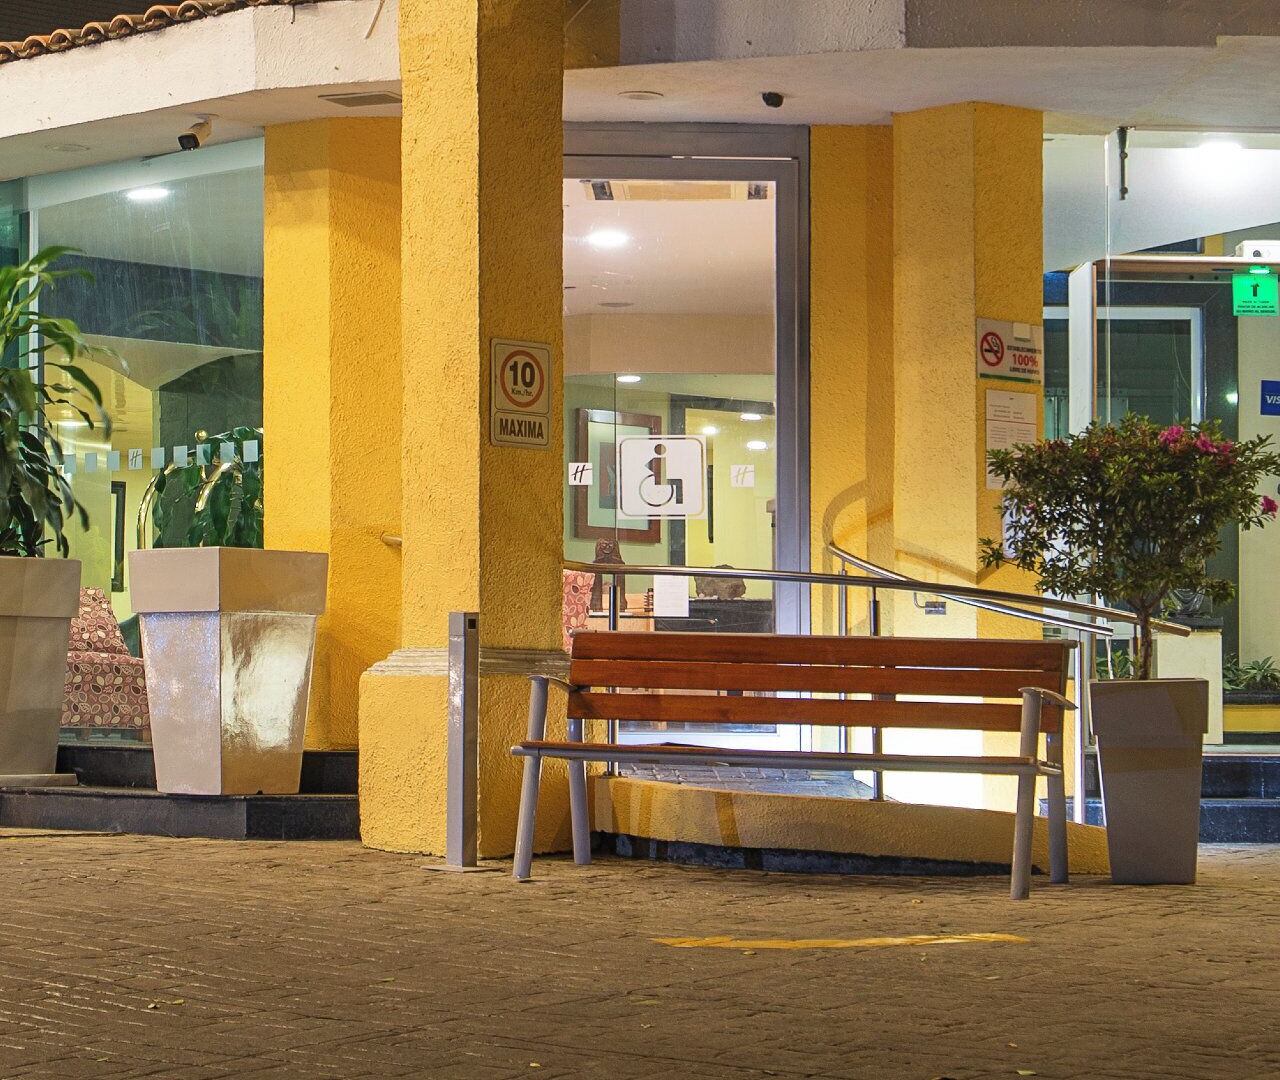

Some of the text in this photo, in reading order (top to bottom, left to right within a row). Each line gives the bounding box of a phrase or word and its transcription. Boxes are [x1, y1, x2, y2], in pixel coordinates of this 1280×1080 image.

[1012, 353, 1039, 368] 100%
[509, 360, 536, 388] 10
[499, 417, 545, 440] MAXIMA
[571, 463, 593, 484] H
